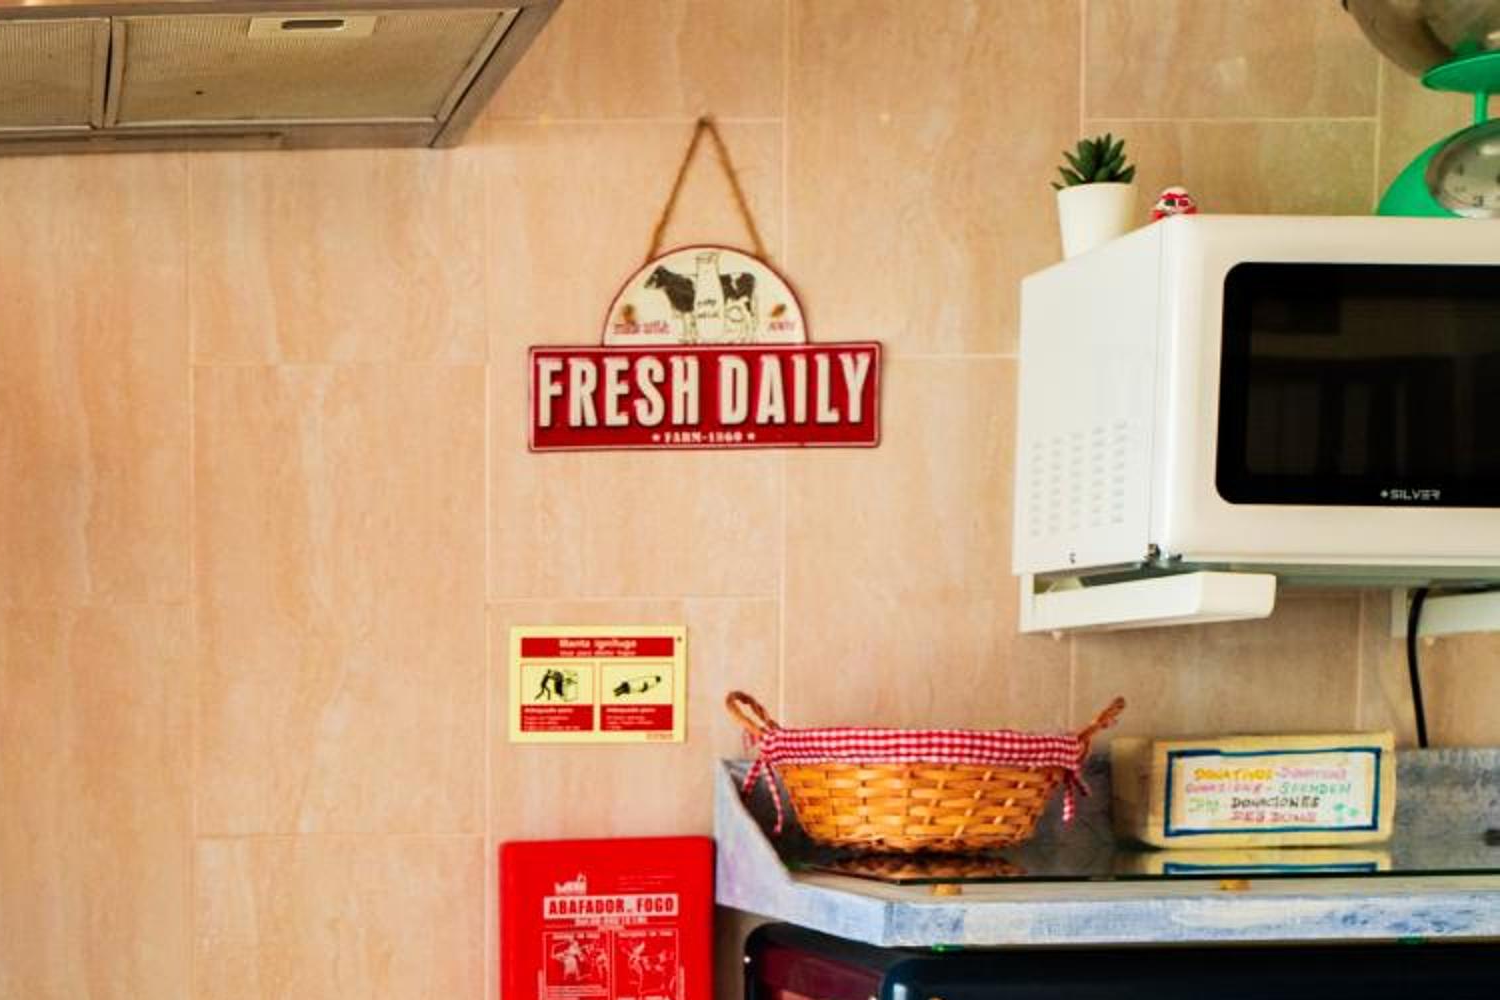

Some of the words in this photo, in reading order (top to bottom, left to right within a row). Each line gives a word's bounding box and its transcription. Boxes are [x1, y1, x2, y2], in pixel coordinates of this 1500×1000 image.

[536, 354, 701, 428] FRESH
[717, 351, 871, 425] DAILY
[1389, 488, 1442, 502] SILVER
[548, 898, 626, 916] ABAFADOR
[636, 895, 675, 914] FOGO
